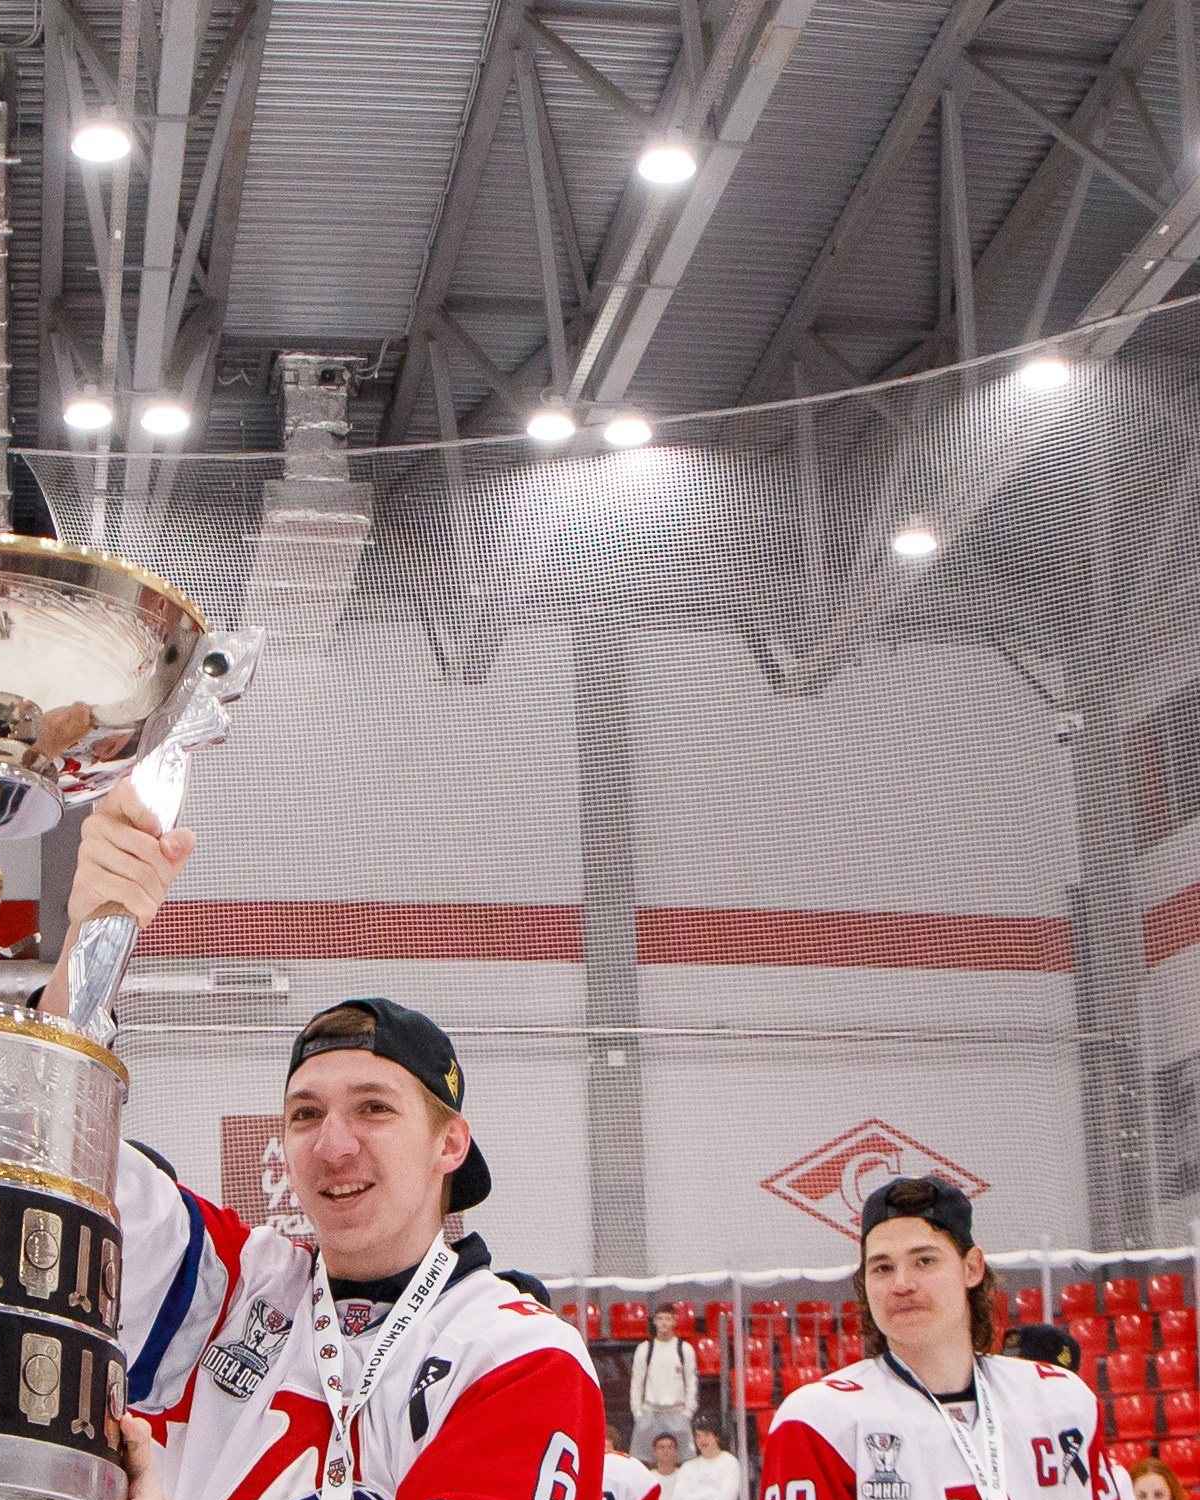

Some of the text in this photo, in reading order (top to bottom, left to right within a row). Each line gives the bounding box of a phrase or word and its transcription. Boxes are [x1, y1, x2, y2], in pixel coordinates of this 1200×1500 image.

[359, 1251, 449, 1396] OLIMPBET ЧЕМПИОНАТ
[202, 1346, 262, 1393] ПЛЕЙ-ОФ
[862, 1481, 911, 1500] ФИНАЛ
